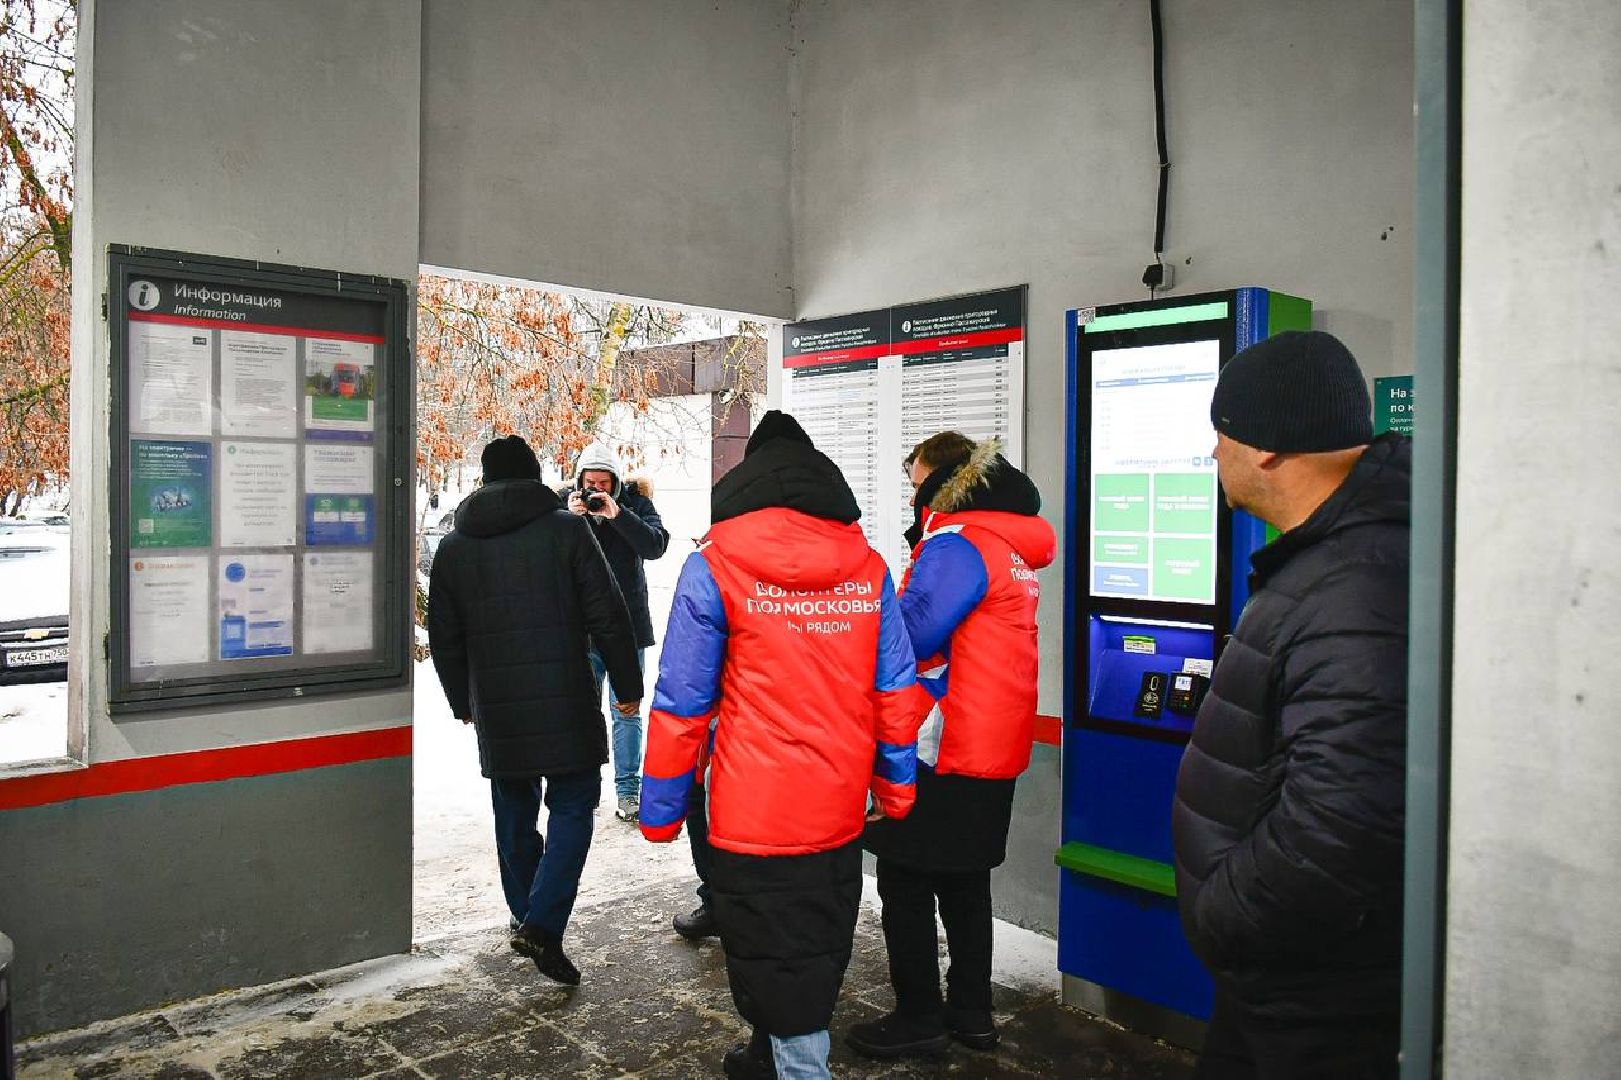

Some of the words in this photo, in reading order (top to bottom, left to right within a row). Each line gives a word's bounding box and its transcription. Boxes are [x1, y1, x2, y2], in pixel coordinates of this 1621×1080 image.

[174, 283, 282, 309] Информация
[173, 304, 247, 321] Information
[1390, 388, 1407, 398] На
[746, 598, 882, 616] ПОДМОСКОВЬЯ
[806, 620, 852, 634] РЯДОМ
